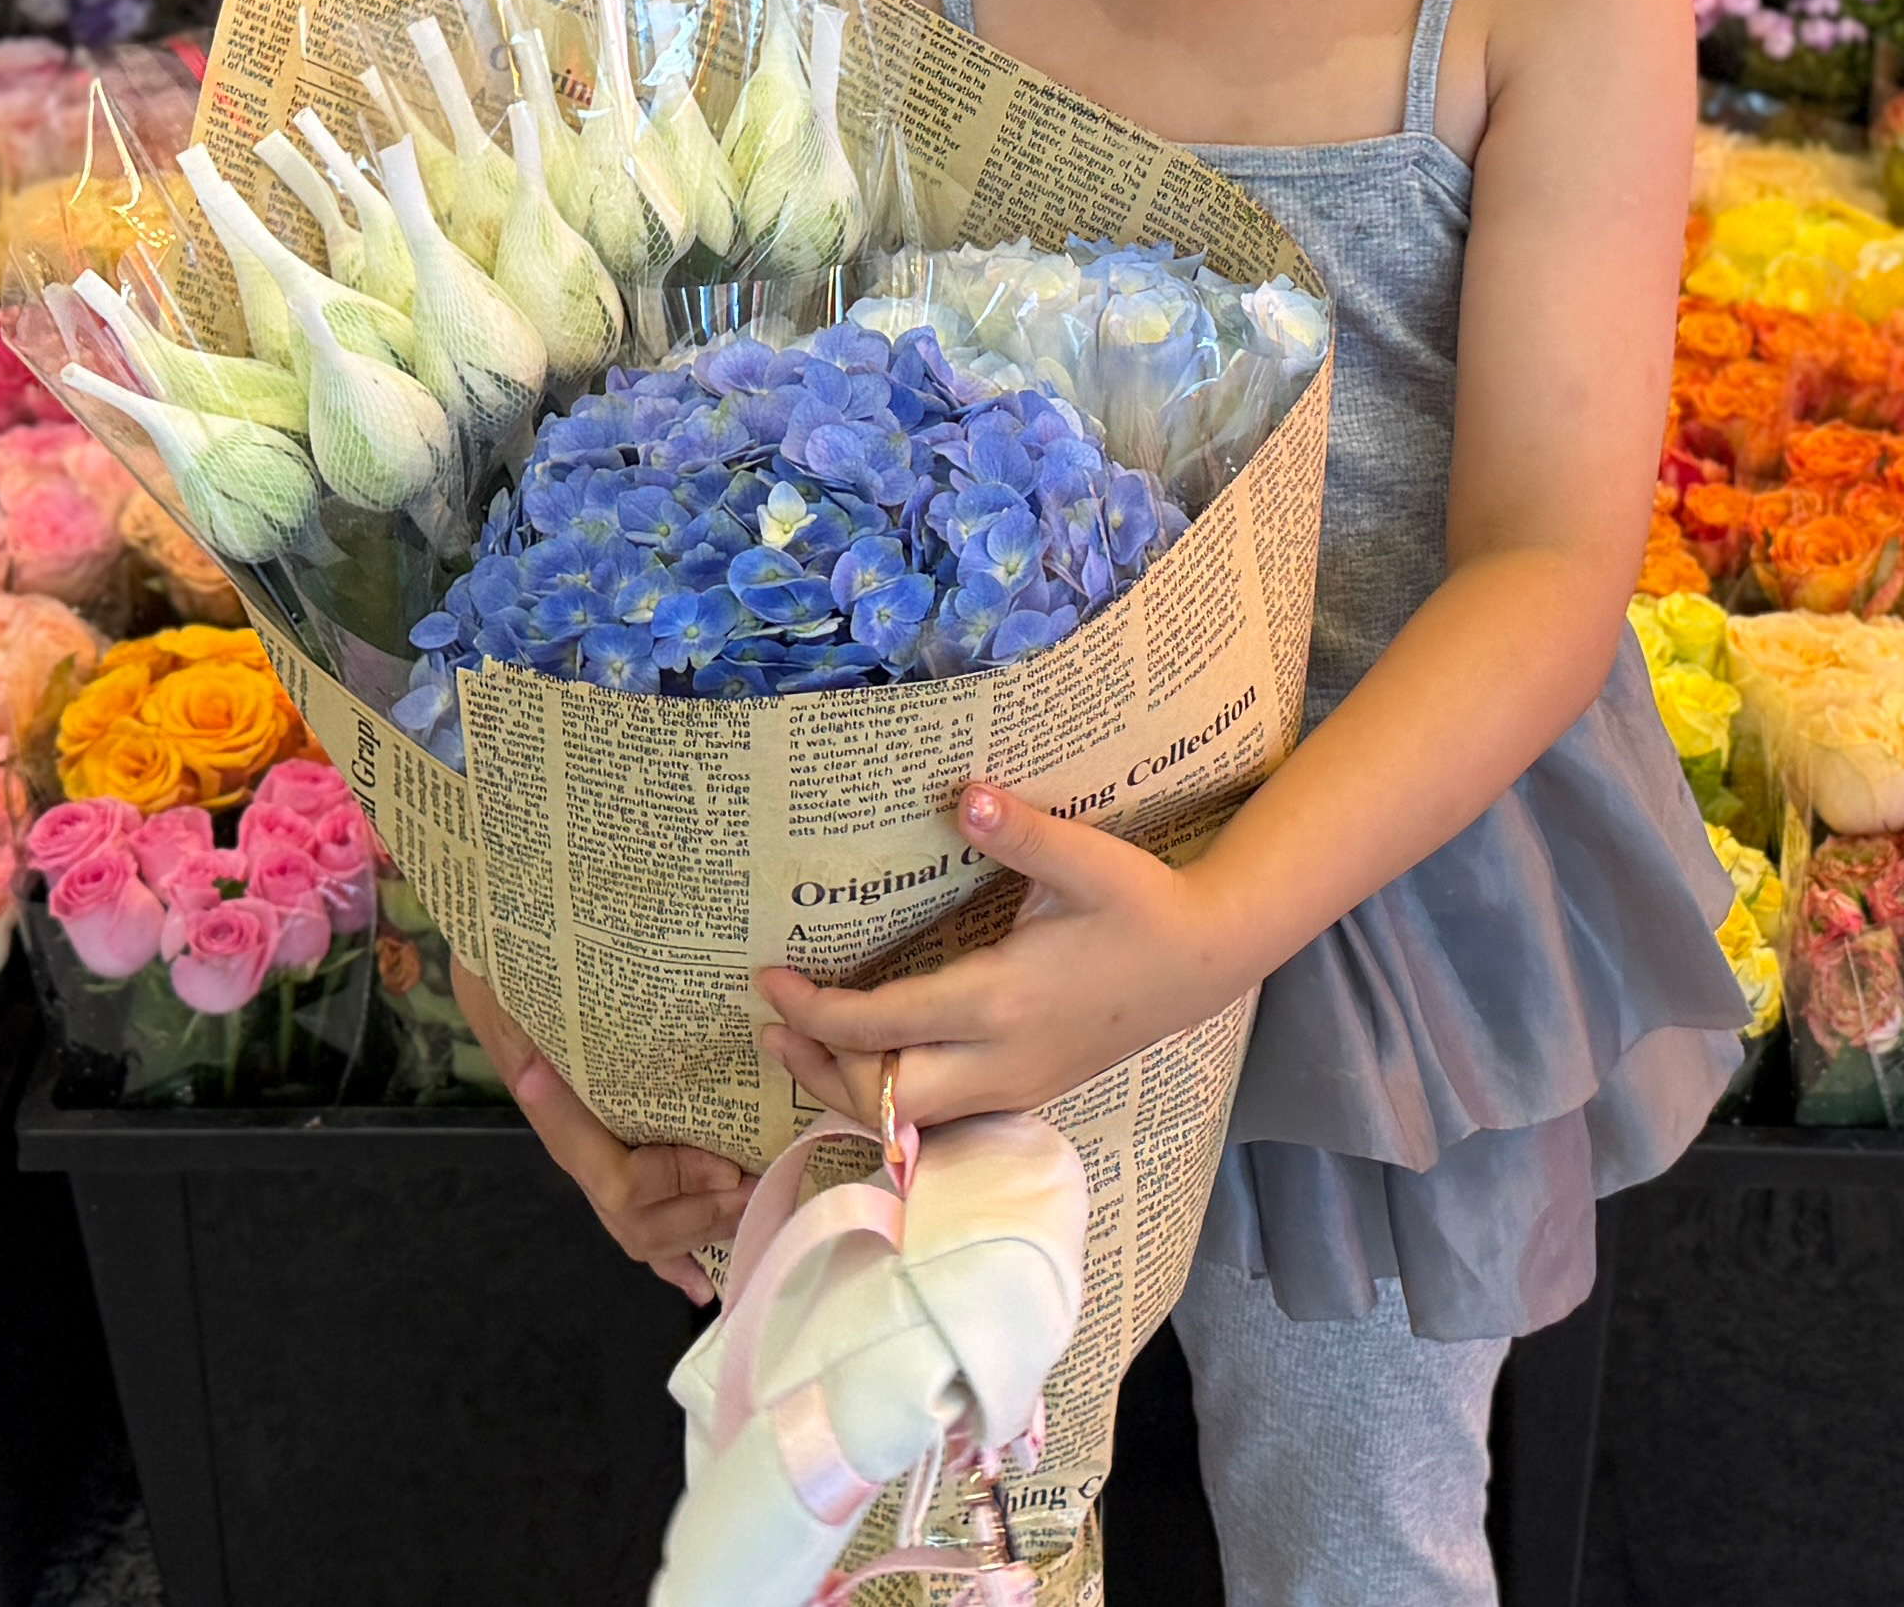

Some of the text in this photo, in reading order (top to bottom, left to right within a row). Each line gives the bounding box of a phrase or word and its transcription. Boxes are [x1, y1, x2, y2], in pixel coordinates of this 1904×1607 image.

[900, 697, 947, 713] picture
[811, 720, 865, 734] delights
[868, 718, 892, 729] the
[1126, 684, 1256, 787] Collection
[352, 707, 381, 789] Grap
[863, 753, 888, 766] and
[791, 854, 949, 907] Original
